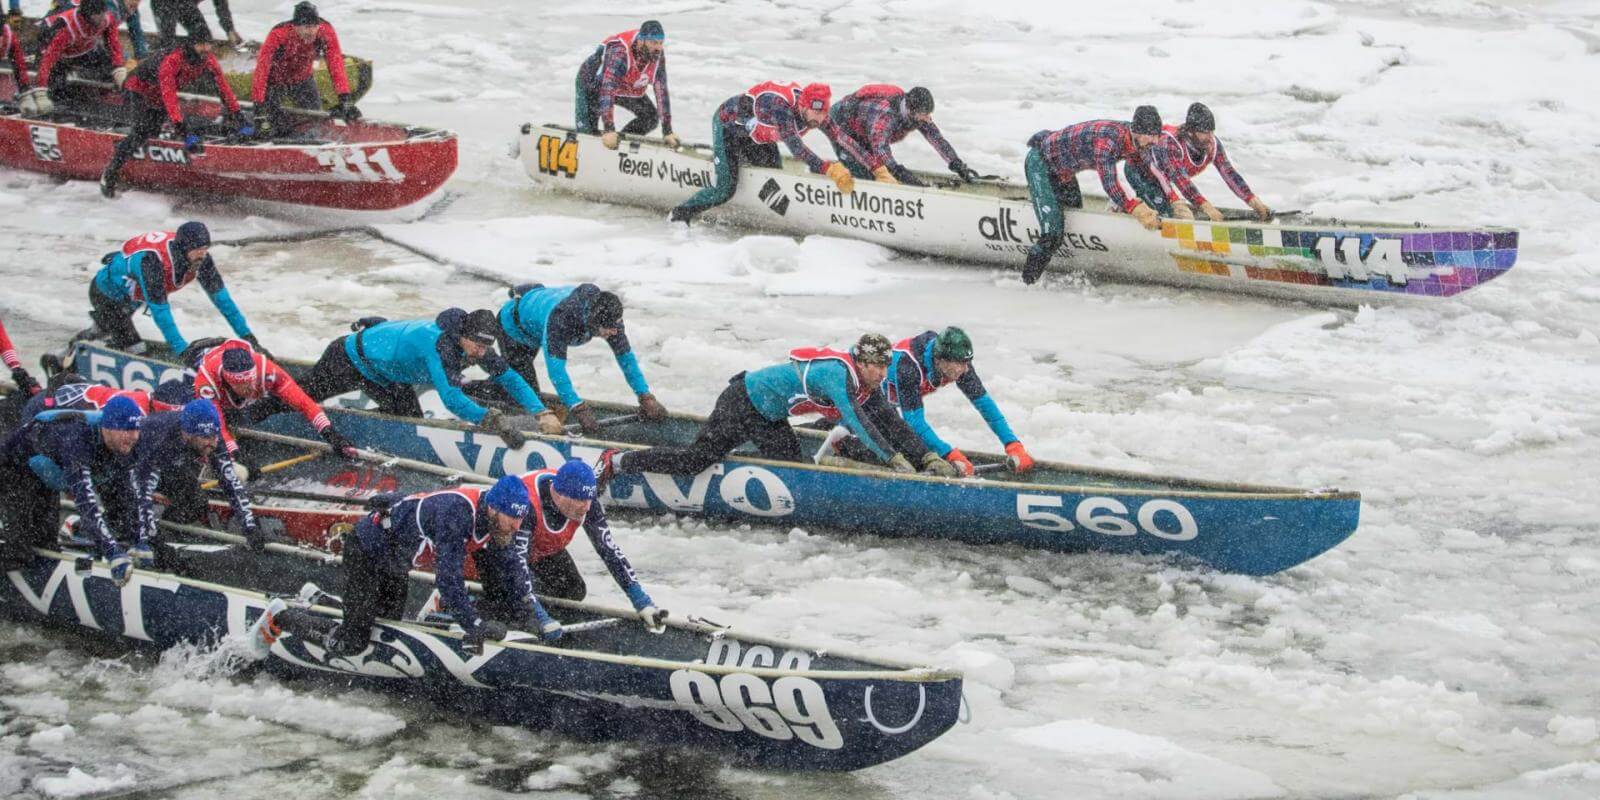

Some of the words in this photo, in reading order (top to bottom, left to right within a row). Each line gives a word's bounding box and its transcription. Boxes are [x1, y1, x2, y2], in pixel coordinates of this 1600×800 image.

[538, 134, 579, 179] 114
[618, 152, 653, 178] Texel
[670, 164, 712, 189] Lydall
[794, 182, 843, 208] Stein
[851, 190, 925, 220] Monast
[830, 213, 896, 234] AVOCATS
[979, 207, 1022, 243] alt
[1026, 227, 1109, 252] HELS
[1315, 235, 1409, 286] 114
[1016, 493, 1198, 542] 560
[669, 669, 845, 750] 969
